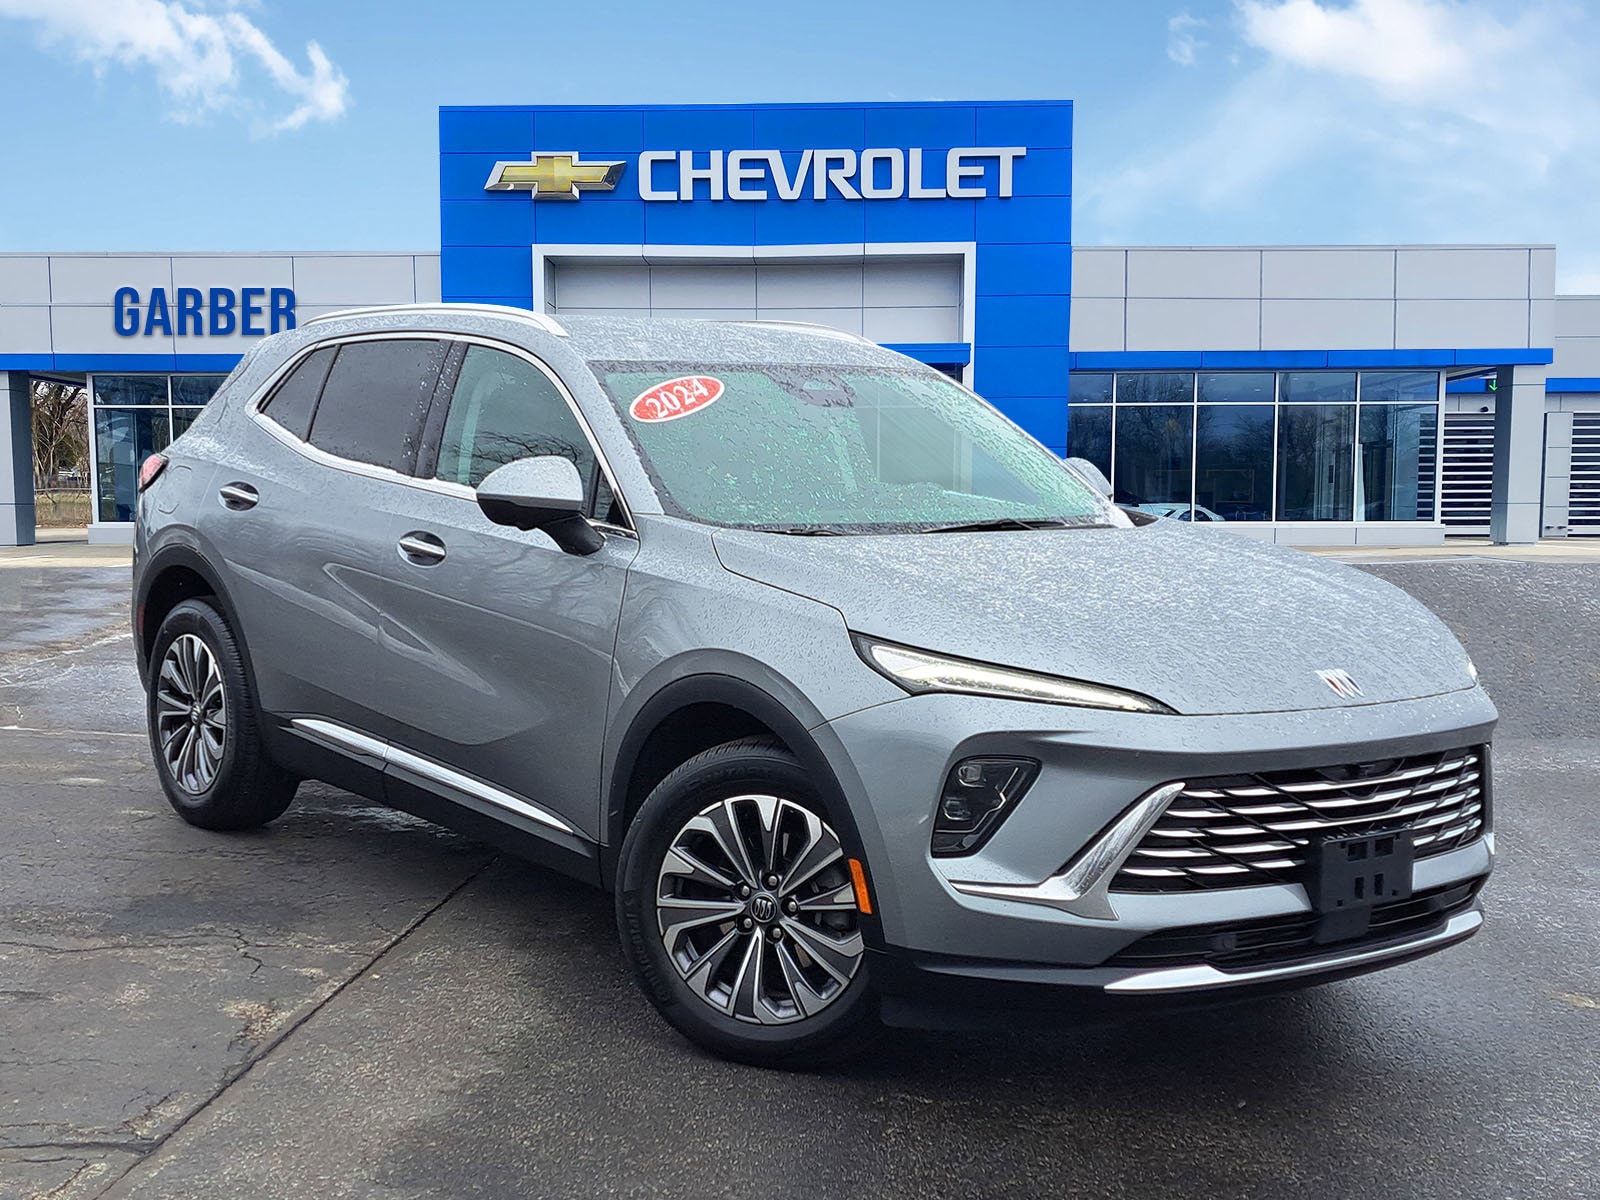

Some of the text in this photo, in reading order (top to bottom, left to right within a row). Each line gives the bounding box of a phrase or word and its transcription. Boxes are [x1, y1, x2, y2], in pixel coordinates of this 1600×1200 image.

[638, 147, 1027, 201] CHEVROLET
[114, 286, 297, 336] GARBER
[645, 378, 710, 418] 2024
